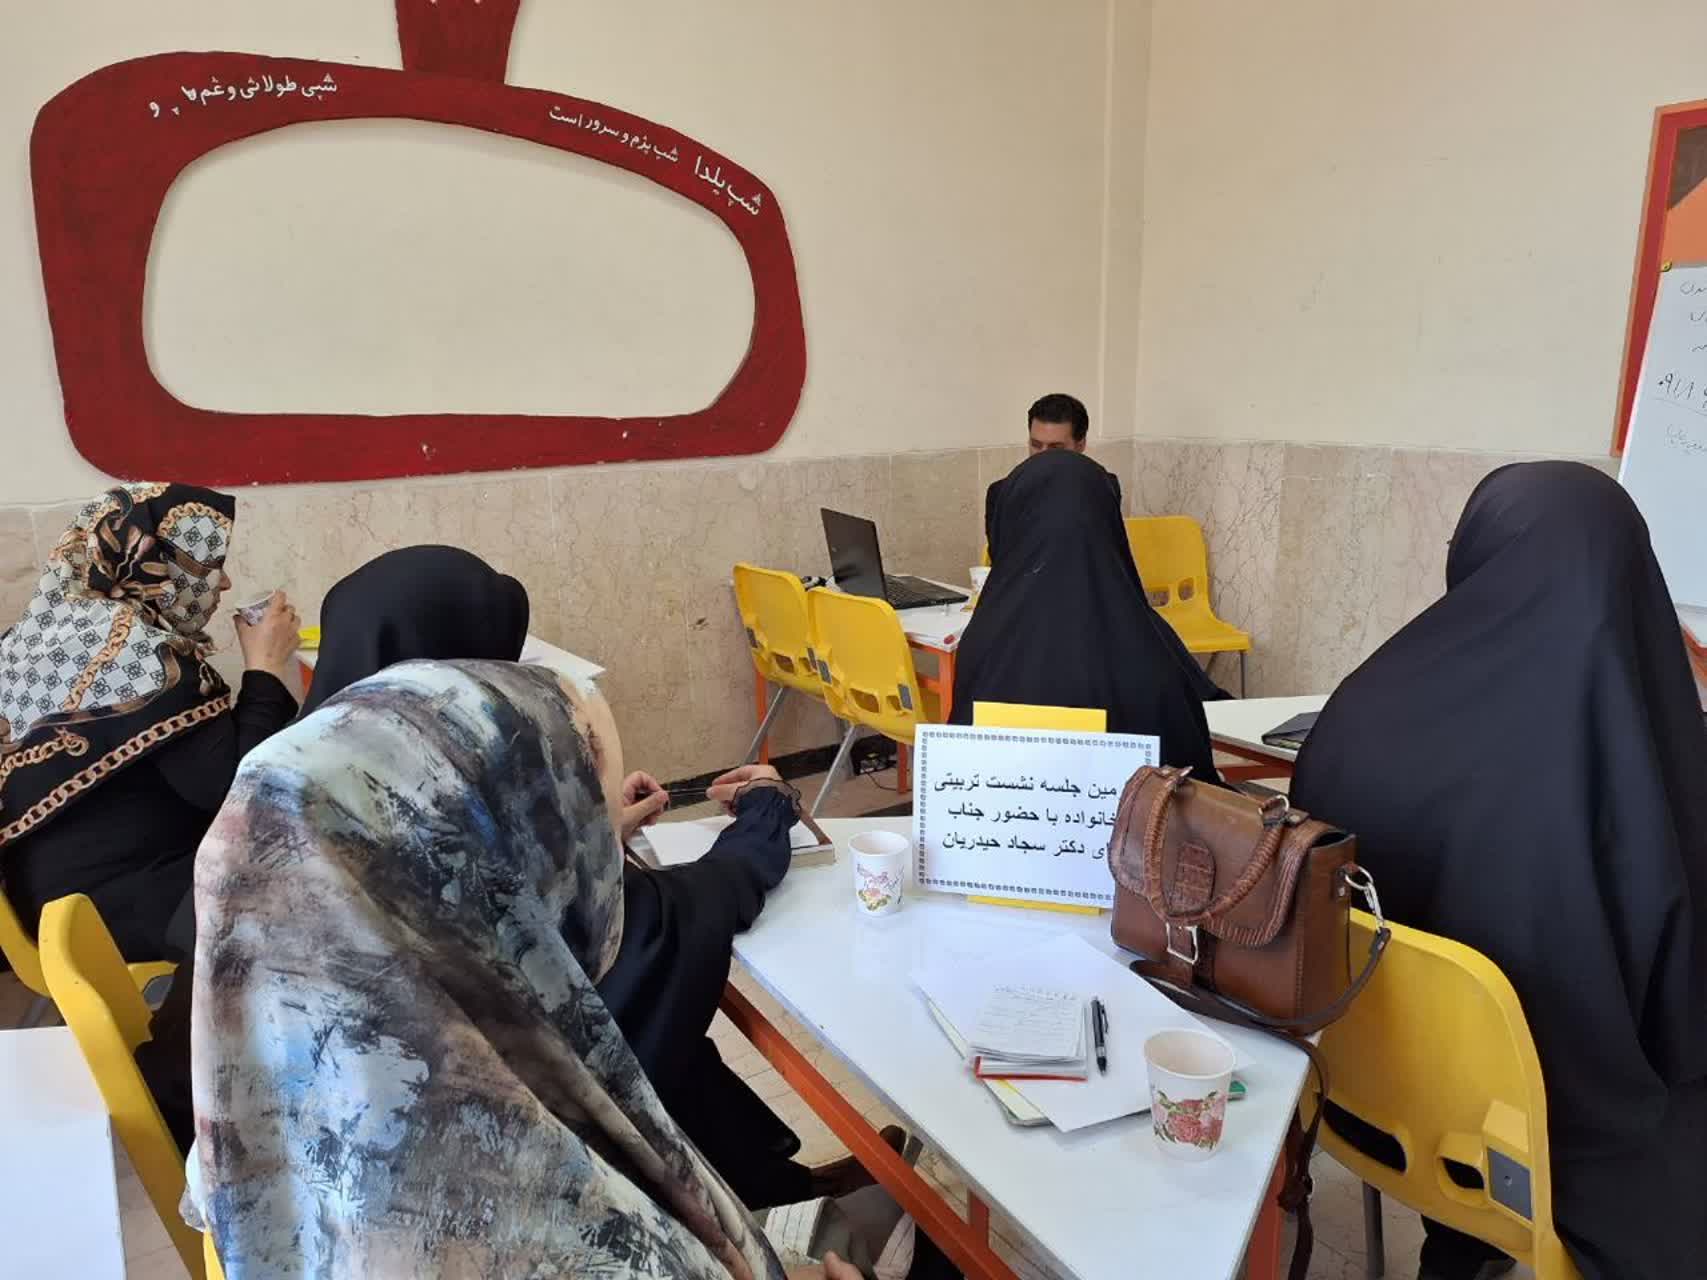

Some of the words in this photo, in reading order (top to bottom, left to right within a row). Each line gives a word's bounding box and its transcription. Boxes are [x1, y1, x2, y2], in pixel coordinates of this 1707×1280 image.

[227, 85, 237, 101] و
[239, 74, 298, 100] طولانی
[300, 73, 338, 101] شبی
[548, 105, 583, 128] است
[584, 118, 620, 137] سرور
[620, 132, 630, 144] و
[630, 135, 652, 154] بزم
[653, 146, 679, 162] شب
[694, 155, 726, 195] یلدا
[726, 184, 761, 216] شب
[933, 772, 980, 793] تربیتی
[985, 775, 1034, 792] نشست
[1040, 778, 1082, 798] جلسه
[947, 801, 985, 821] جناب
[992, 806, 1040, 824] حضور
[1046, 807, 1058, 826] با
[942, 831, 1001, 851] حیدریان
[1007, 835, 1046, 855] سجاد
[1053, 840, 1085, 857] دکتر
